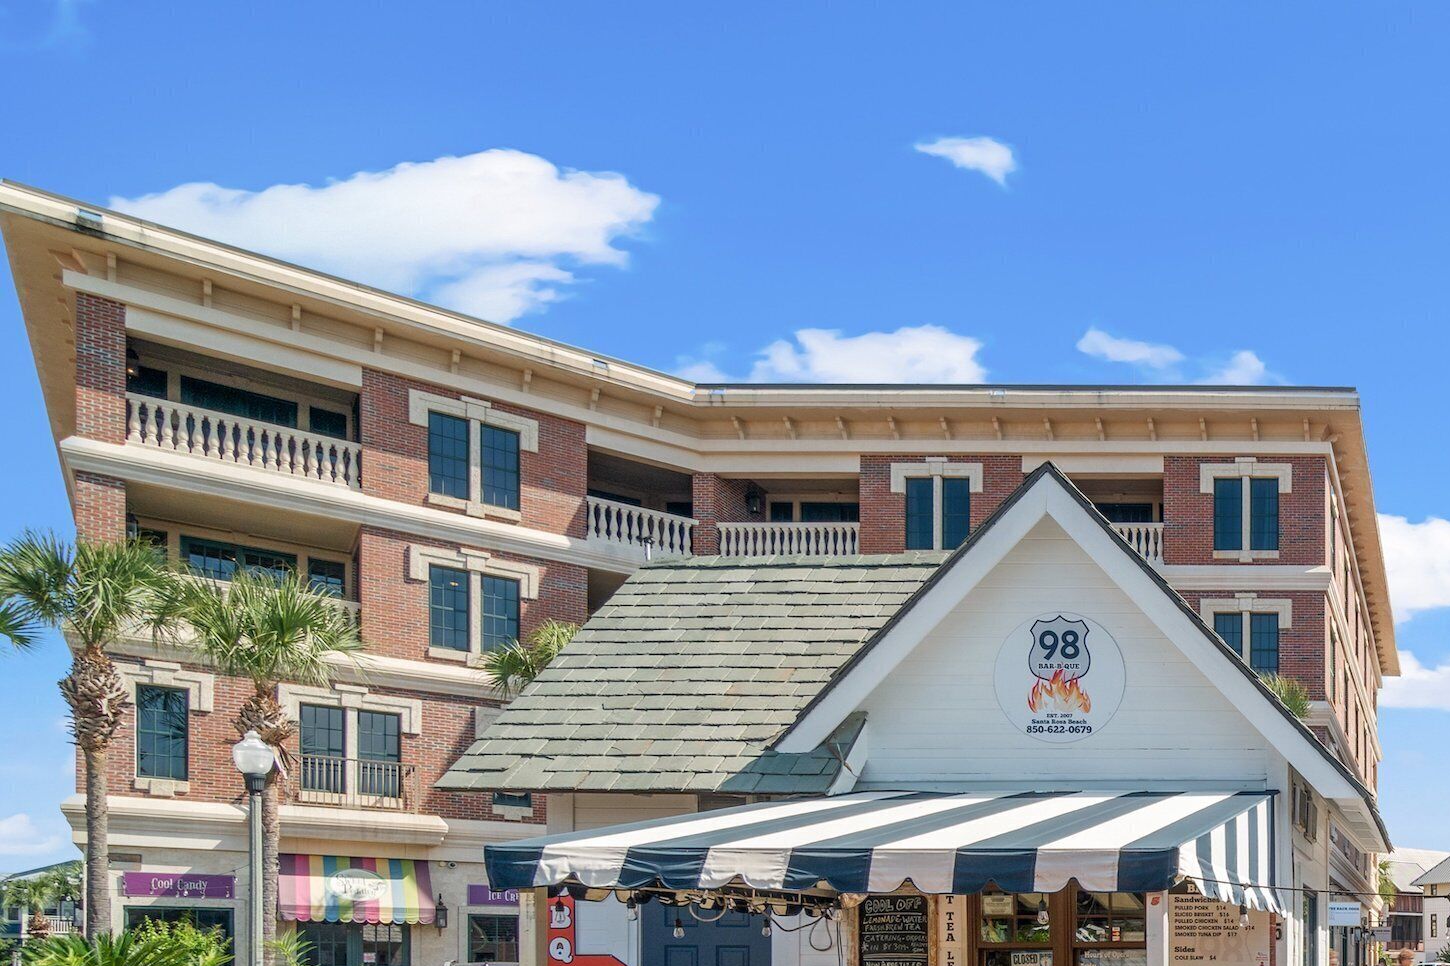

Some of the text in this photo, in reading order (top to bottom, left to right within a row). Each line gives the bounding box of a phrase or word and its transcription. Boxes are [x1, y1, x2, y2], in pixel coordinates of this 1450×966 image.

[1039, 630, 1080, 660] 98
[1026, 725, 1092, 733] 850-622-0679
[151, 878, 207, 891] Cool Candy
[865, 897, 922, 913] COOL OFF
[946, 912, 955, 942] TEA
[1013, 954, 1038, 965] CLOSED
[1084, 950, 1103, 959] Hours
